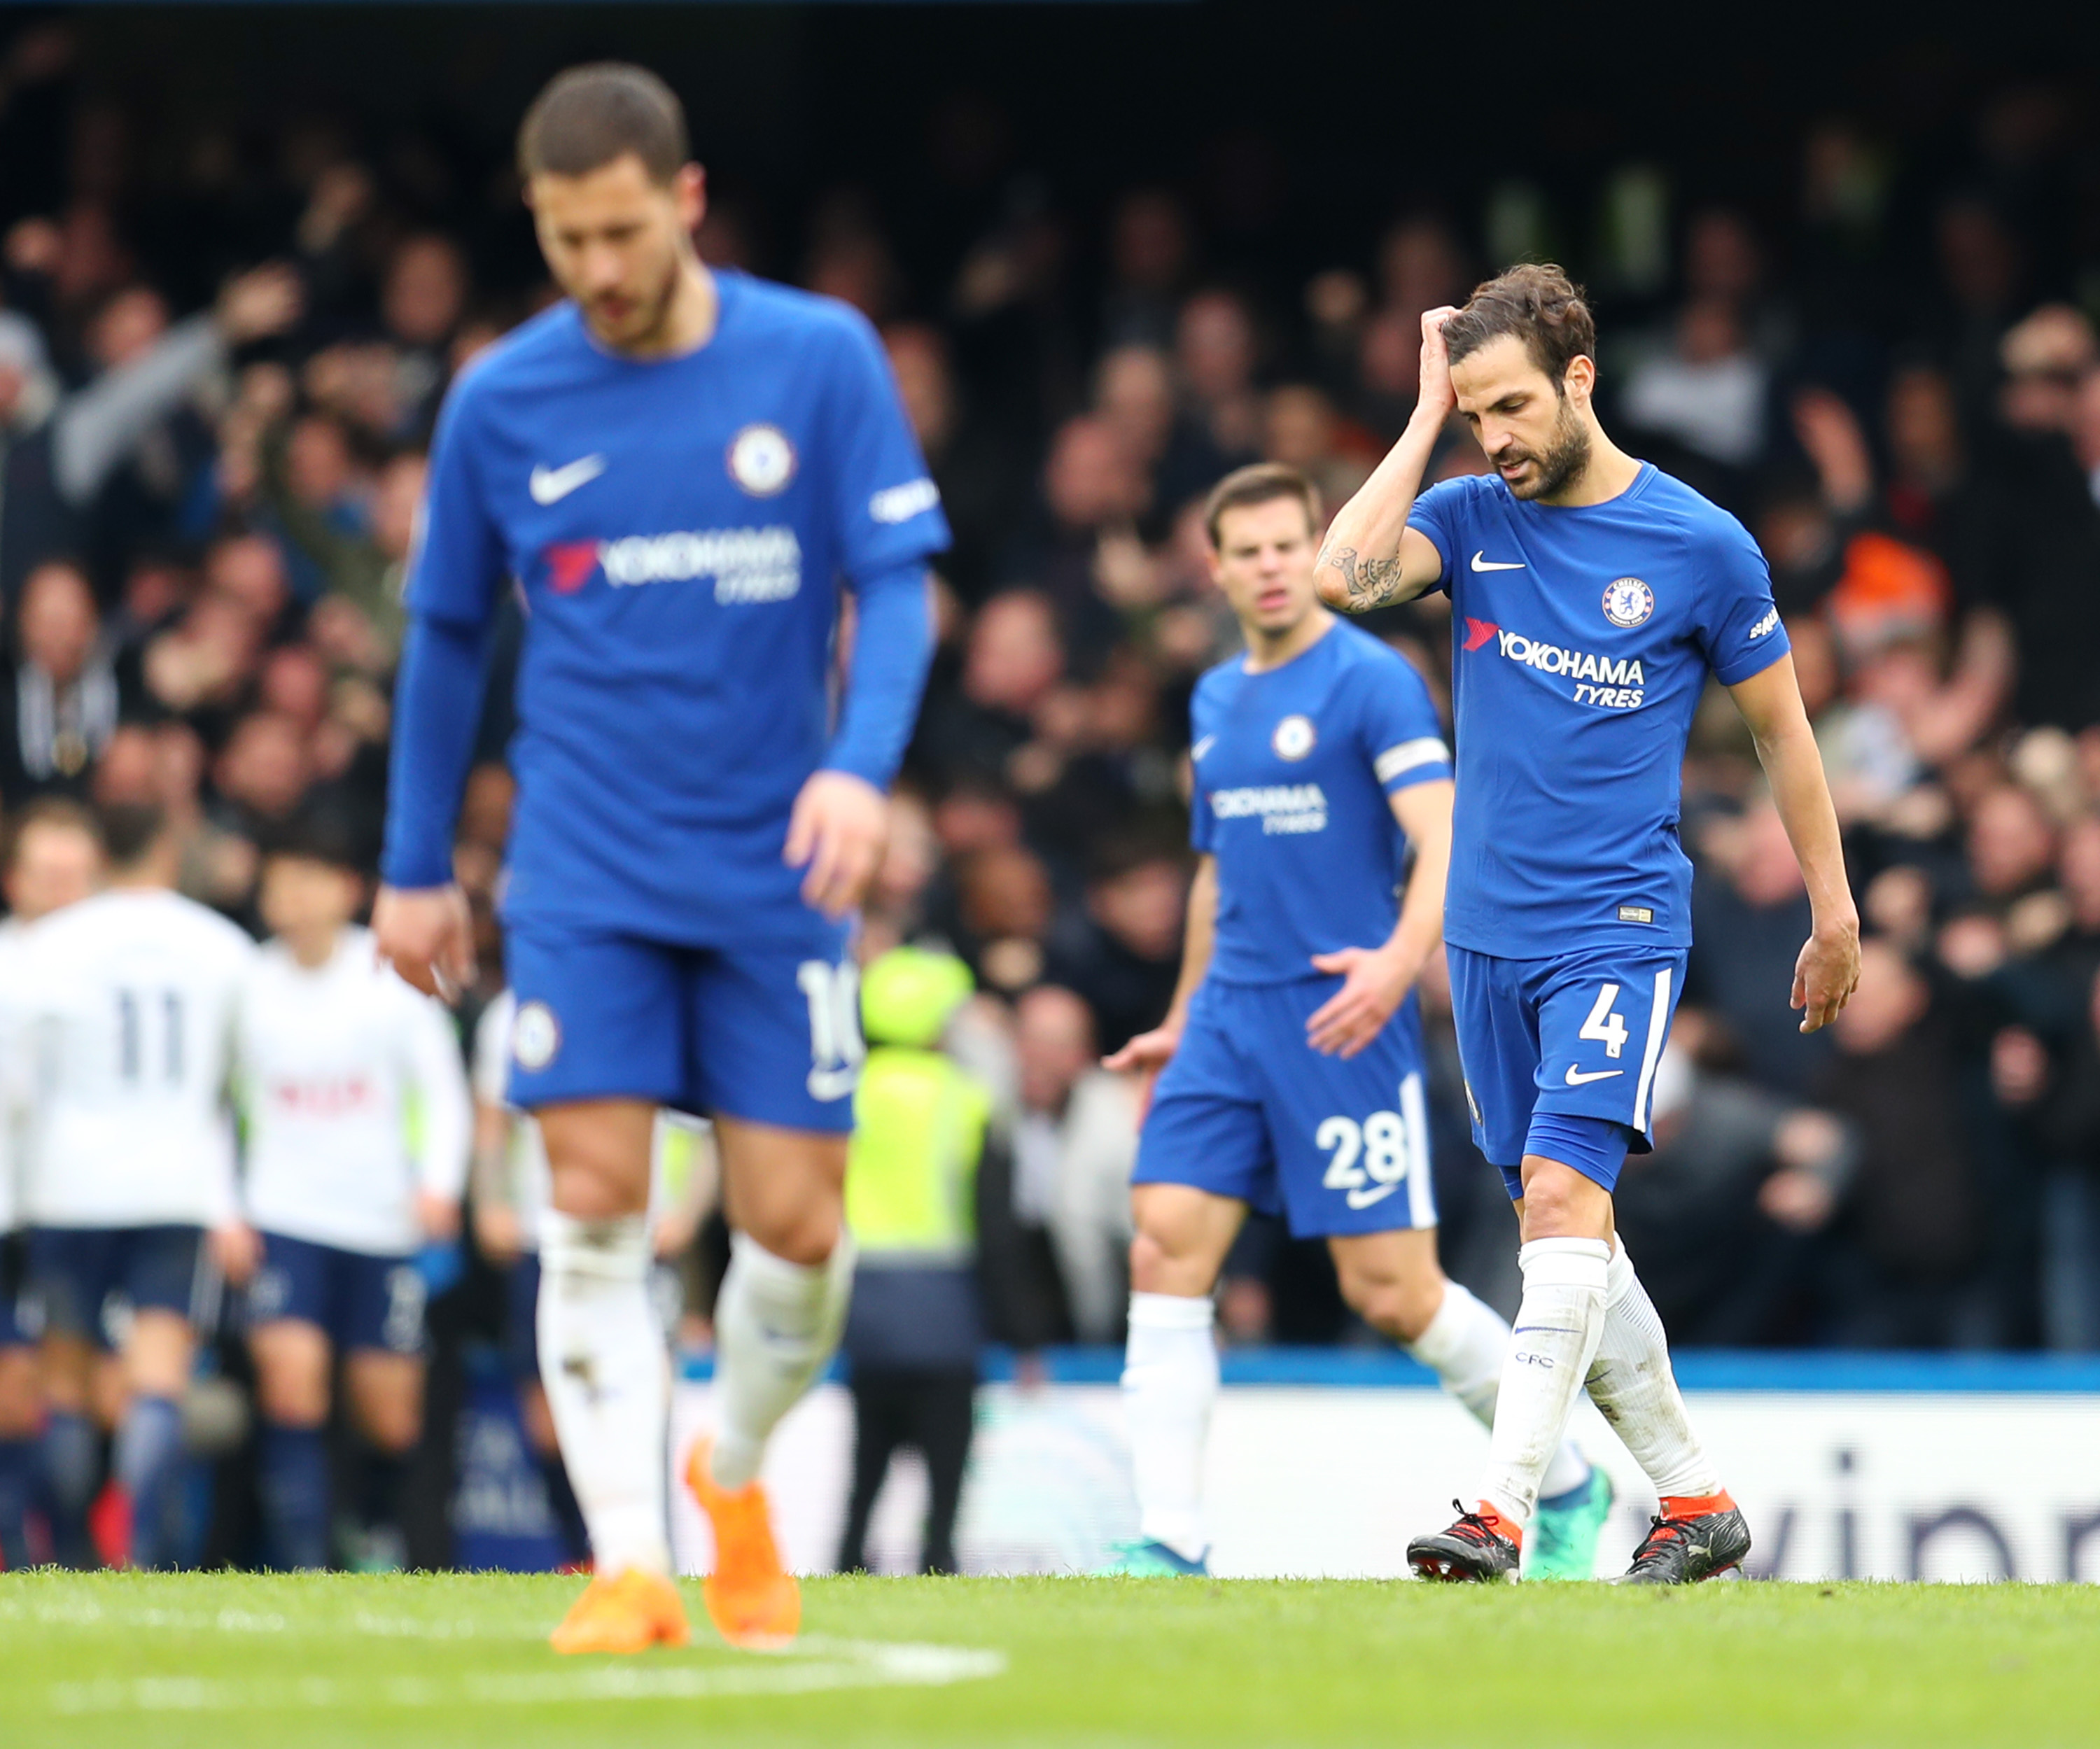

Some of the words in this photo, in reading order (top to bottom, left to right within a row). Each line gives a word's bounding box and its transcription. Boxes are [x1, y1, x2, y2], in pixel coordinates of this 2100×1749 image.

[1498, 629, 1644, 685] YOKOHAMA
[1574, 684, 1644, 708] TYRES
[115, 985, 183, 1093] 11
[1579, 983, 1629, 1059] 4
[1316, 1110, 1408, 1190] 28
[1516, 1352, 1555, 1368] CFC
